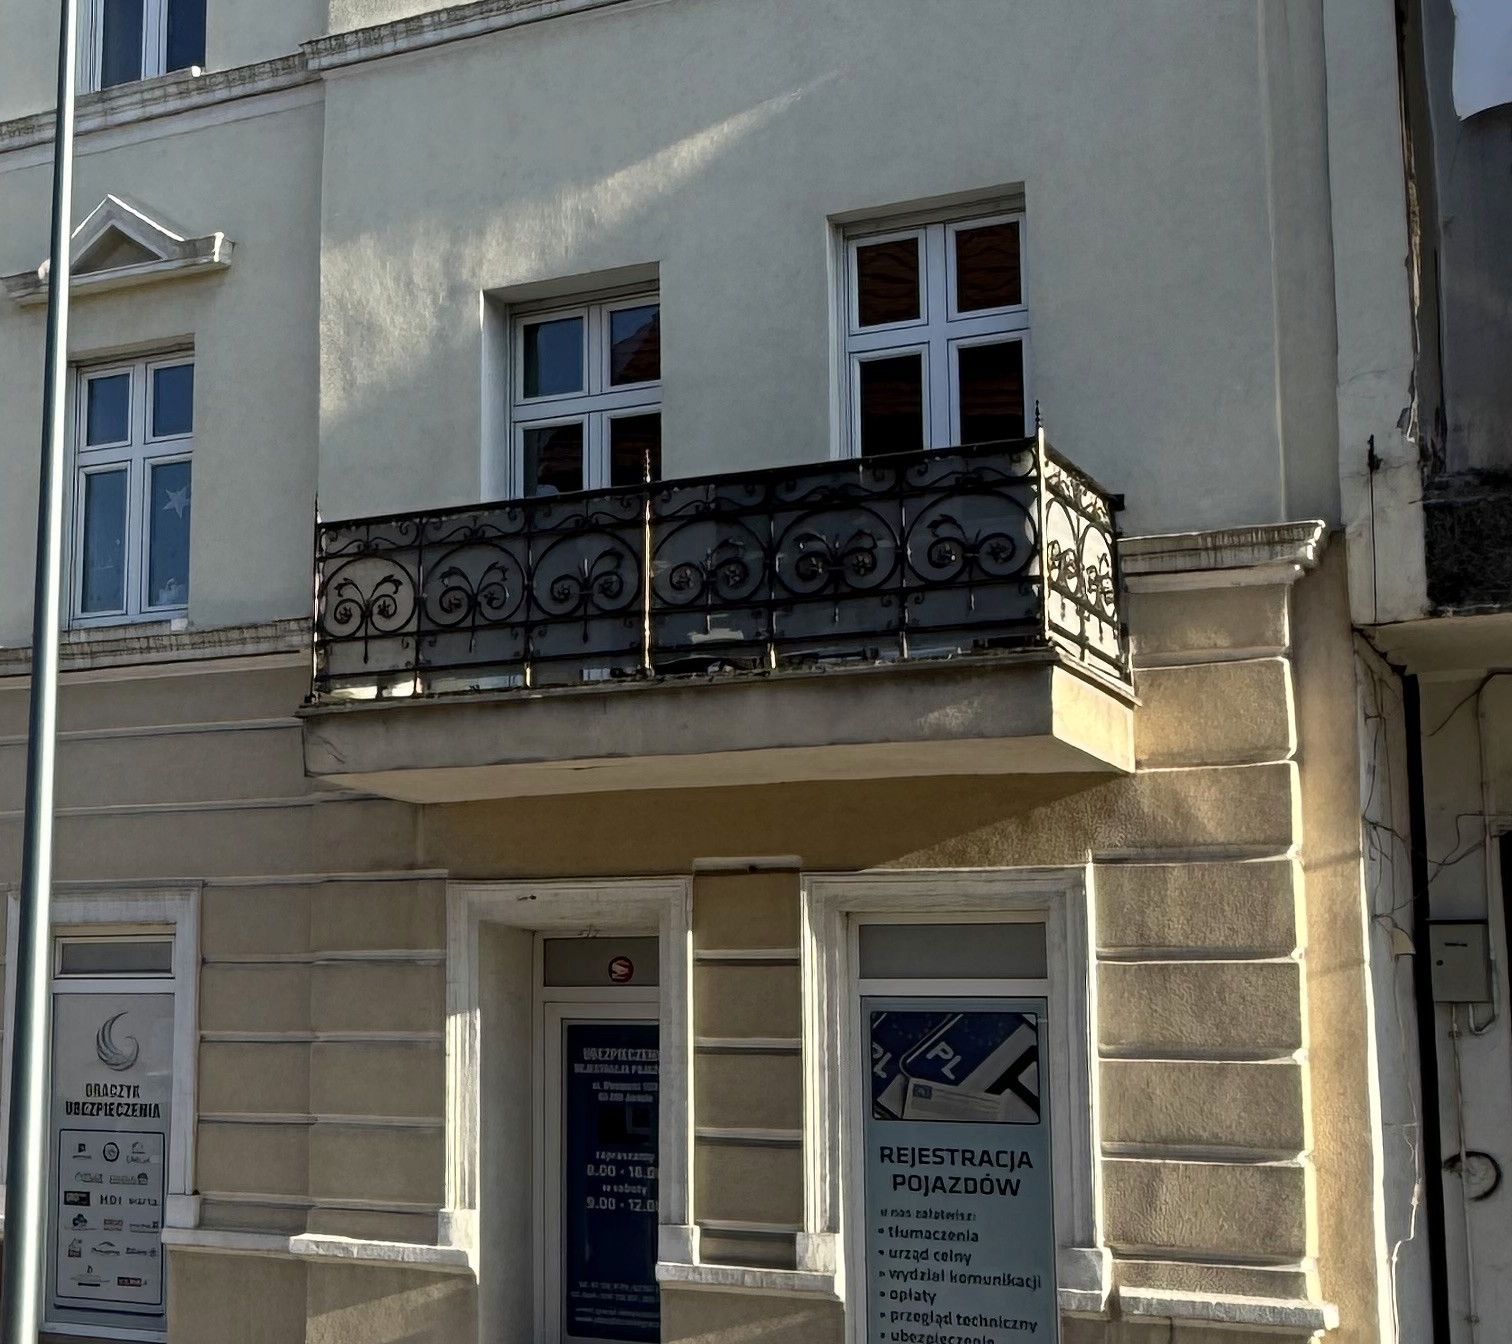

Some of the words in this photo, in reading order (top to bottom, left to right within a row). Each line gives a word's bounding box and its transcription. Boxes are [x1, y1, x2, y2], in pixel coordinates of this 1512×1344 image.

[925, 1041, 962, 1080] PL
[65, 1101, 161, 1119] UBEZPIECZENIA
[879, 1146, 1034, 1172] REJESTRACJA
[892, 1173, 1021, 1197] POJAZDÓW
[586, 1196, 616, 1210] 9.00
[955, 1313, 1037, 1334] techniczny
